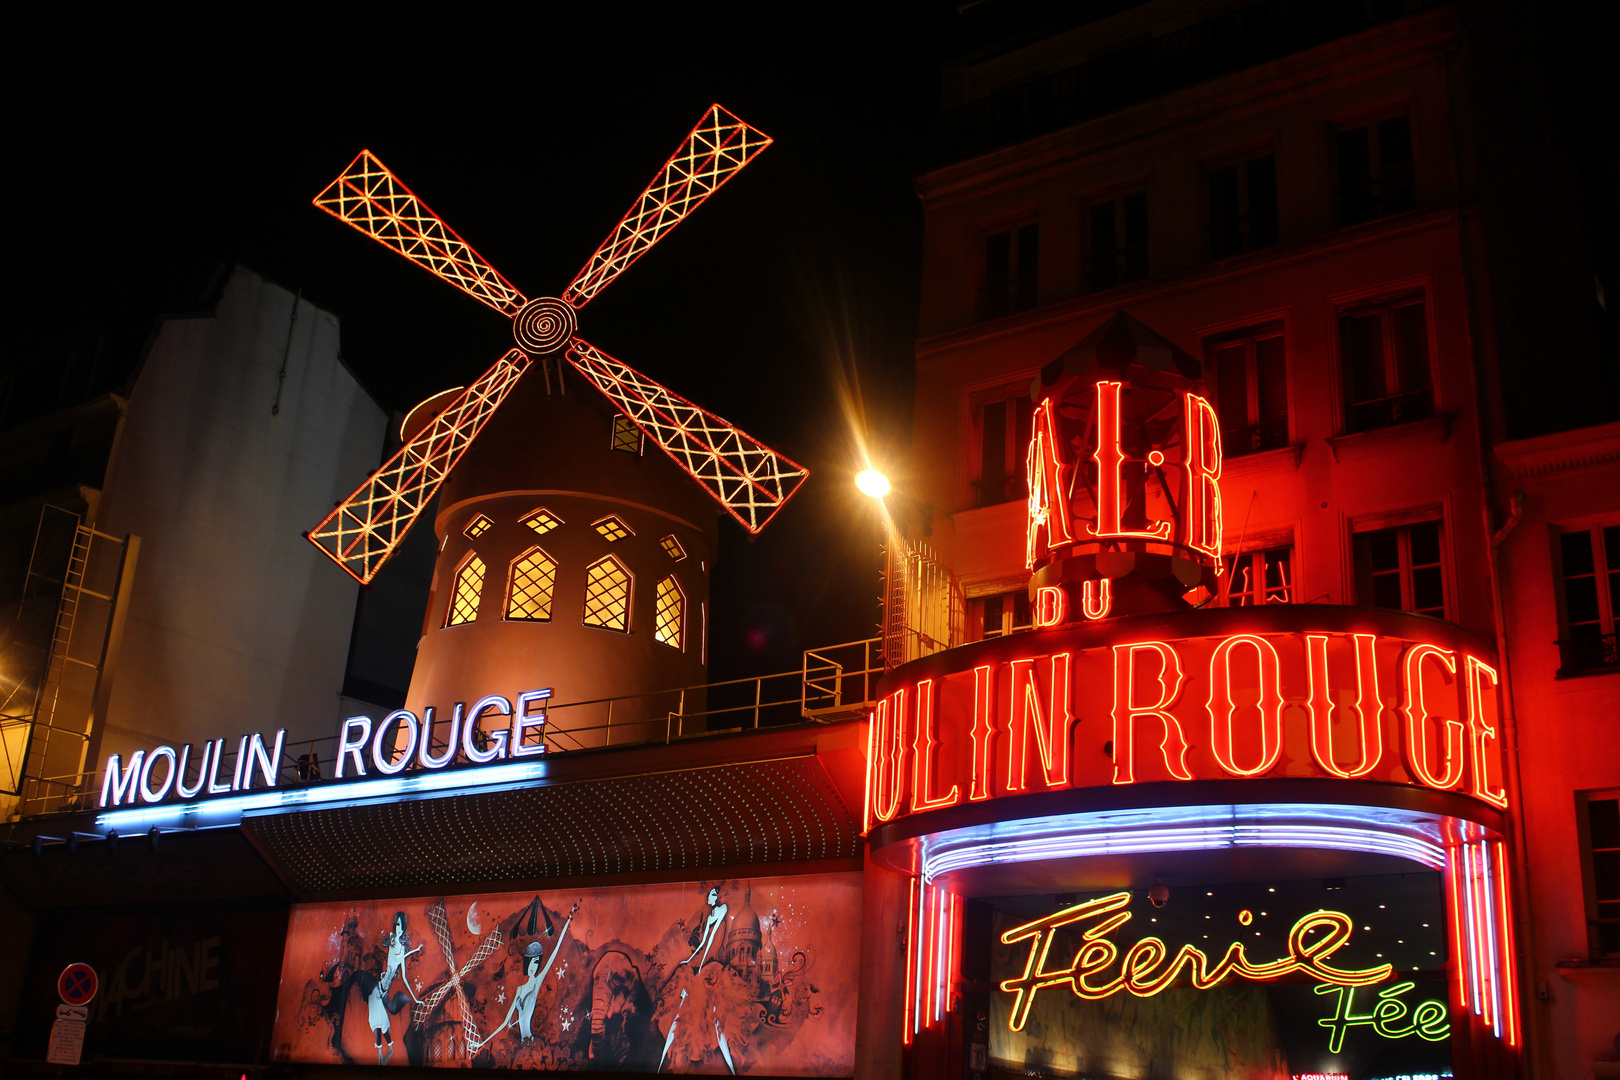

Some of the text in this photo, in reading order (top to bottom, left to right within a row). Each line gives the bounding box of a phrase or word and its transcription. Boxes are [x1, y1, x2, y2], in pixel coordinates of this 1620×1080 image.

[1036, 578, 1111, 627] DU
[99, 687, 554, 808] MOULIN ROUGE
[863, 633, 1509, 835] ULIN ROUGE
[1000, 892, 1393, 1032] Féerie
